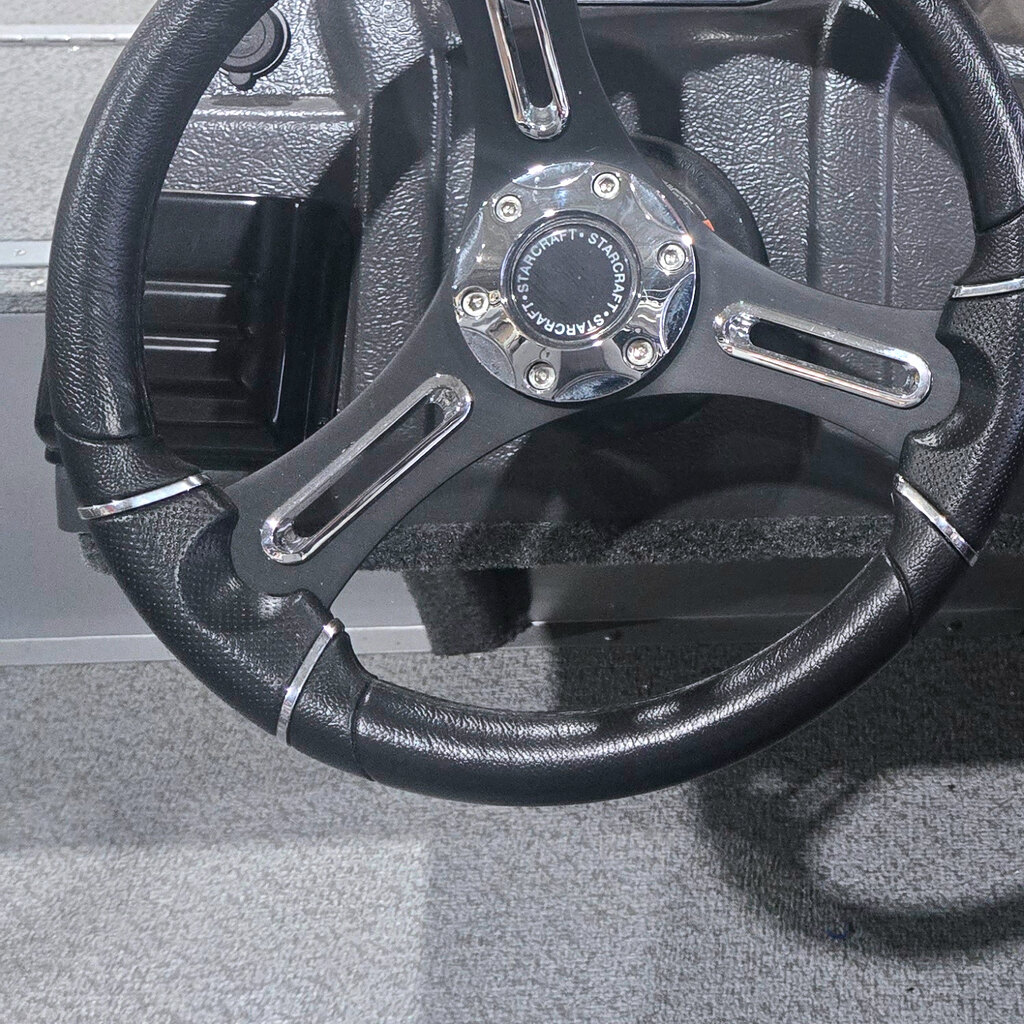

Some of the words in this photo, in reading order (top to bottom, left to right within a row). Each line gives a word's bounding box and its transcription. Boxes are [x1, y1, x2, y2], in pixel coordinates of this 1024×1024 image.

[517, 229, 577, 293] STARCRAFT
[588, 232, 626, 313] STARCRAFT
[521, 302, 605, 336] STARCRAFT
